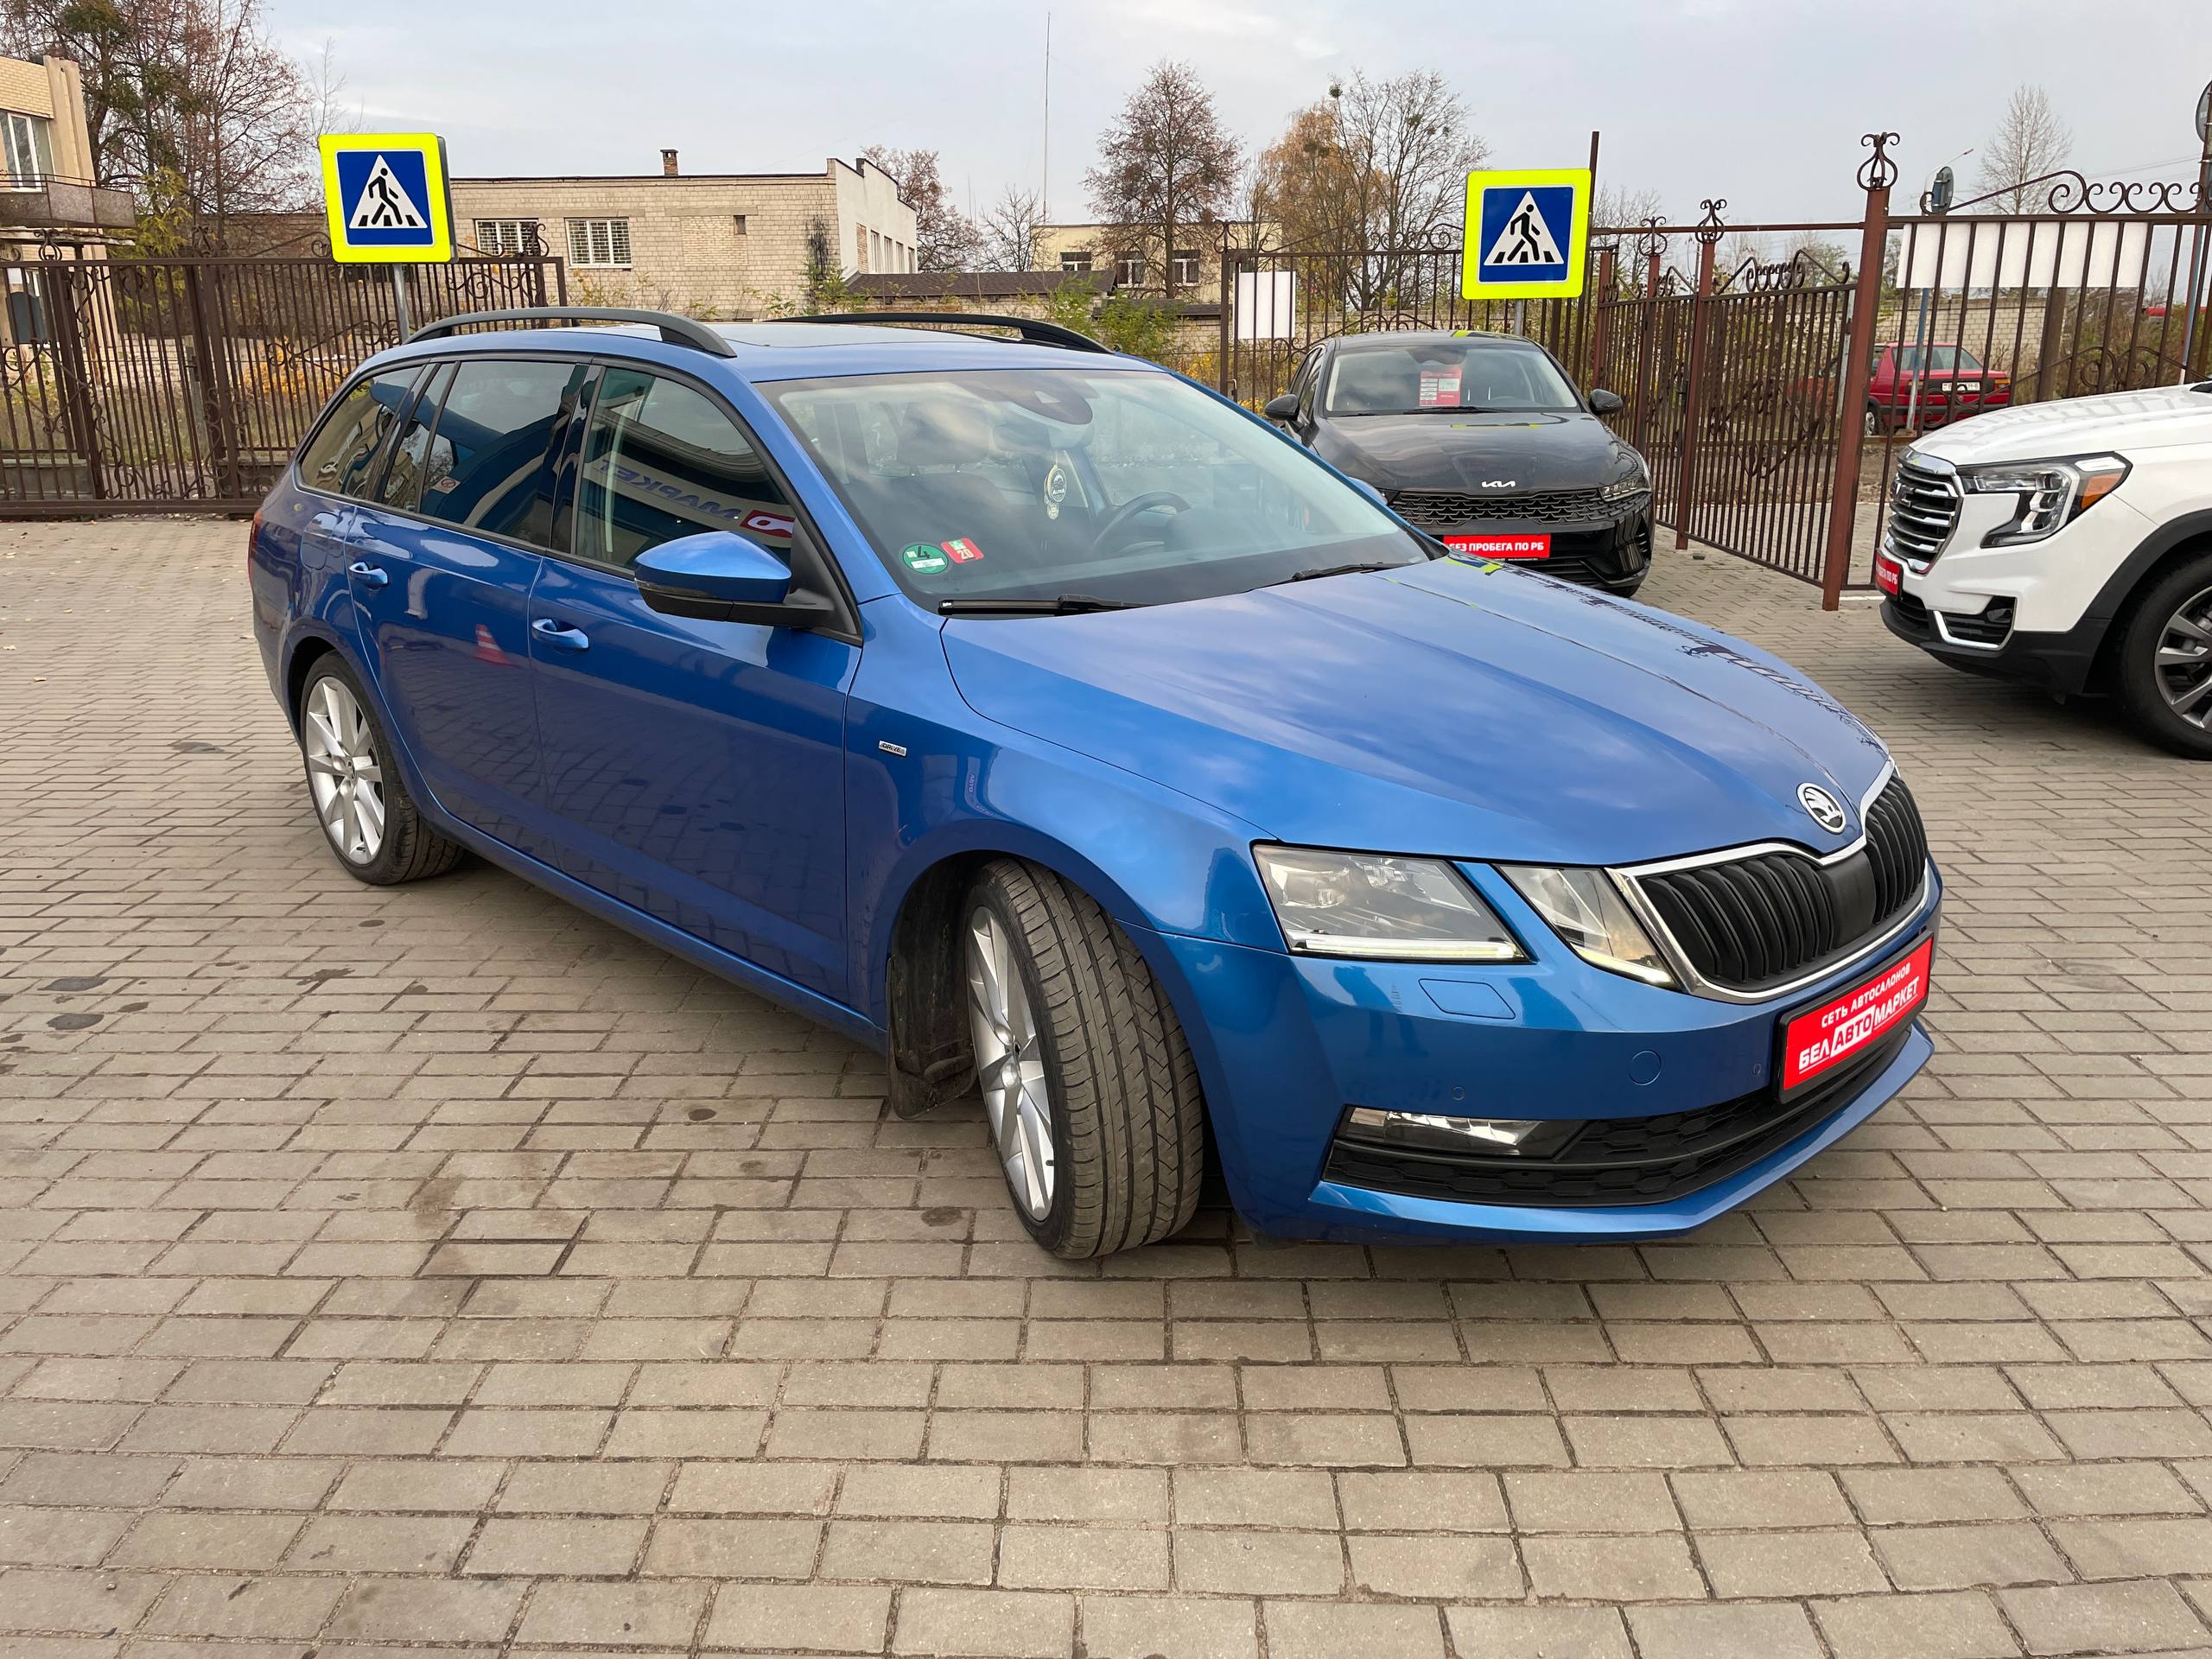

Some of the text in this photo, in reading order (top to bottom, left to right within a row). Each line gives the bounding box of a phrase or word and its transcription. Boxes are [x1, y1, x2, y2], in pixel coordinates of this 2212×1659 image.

[917, 545, 931, 559] 4
[957, 548, 975, 560] 20
[1469, 542, 1513, 552] ПРОБЕГА
[1515, 542, 1529, 551] ПО
[1530, 542, 1544, 551] РБ
[1821, 962, 1911, 1028] СЕТЬ АВТОСАЛОНОВ
[1798, 976, 1920, 1071] БЕЛАВТОМАРКЕТ
